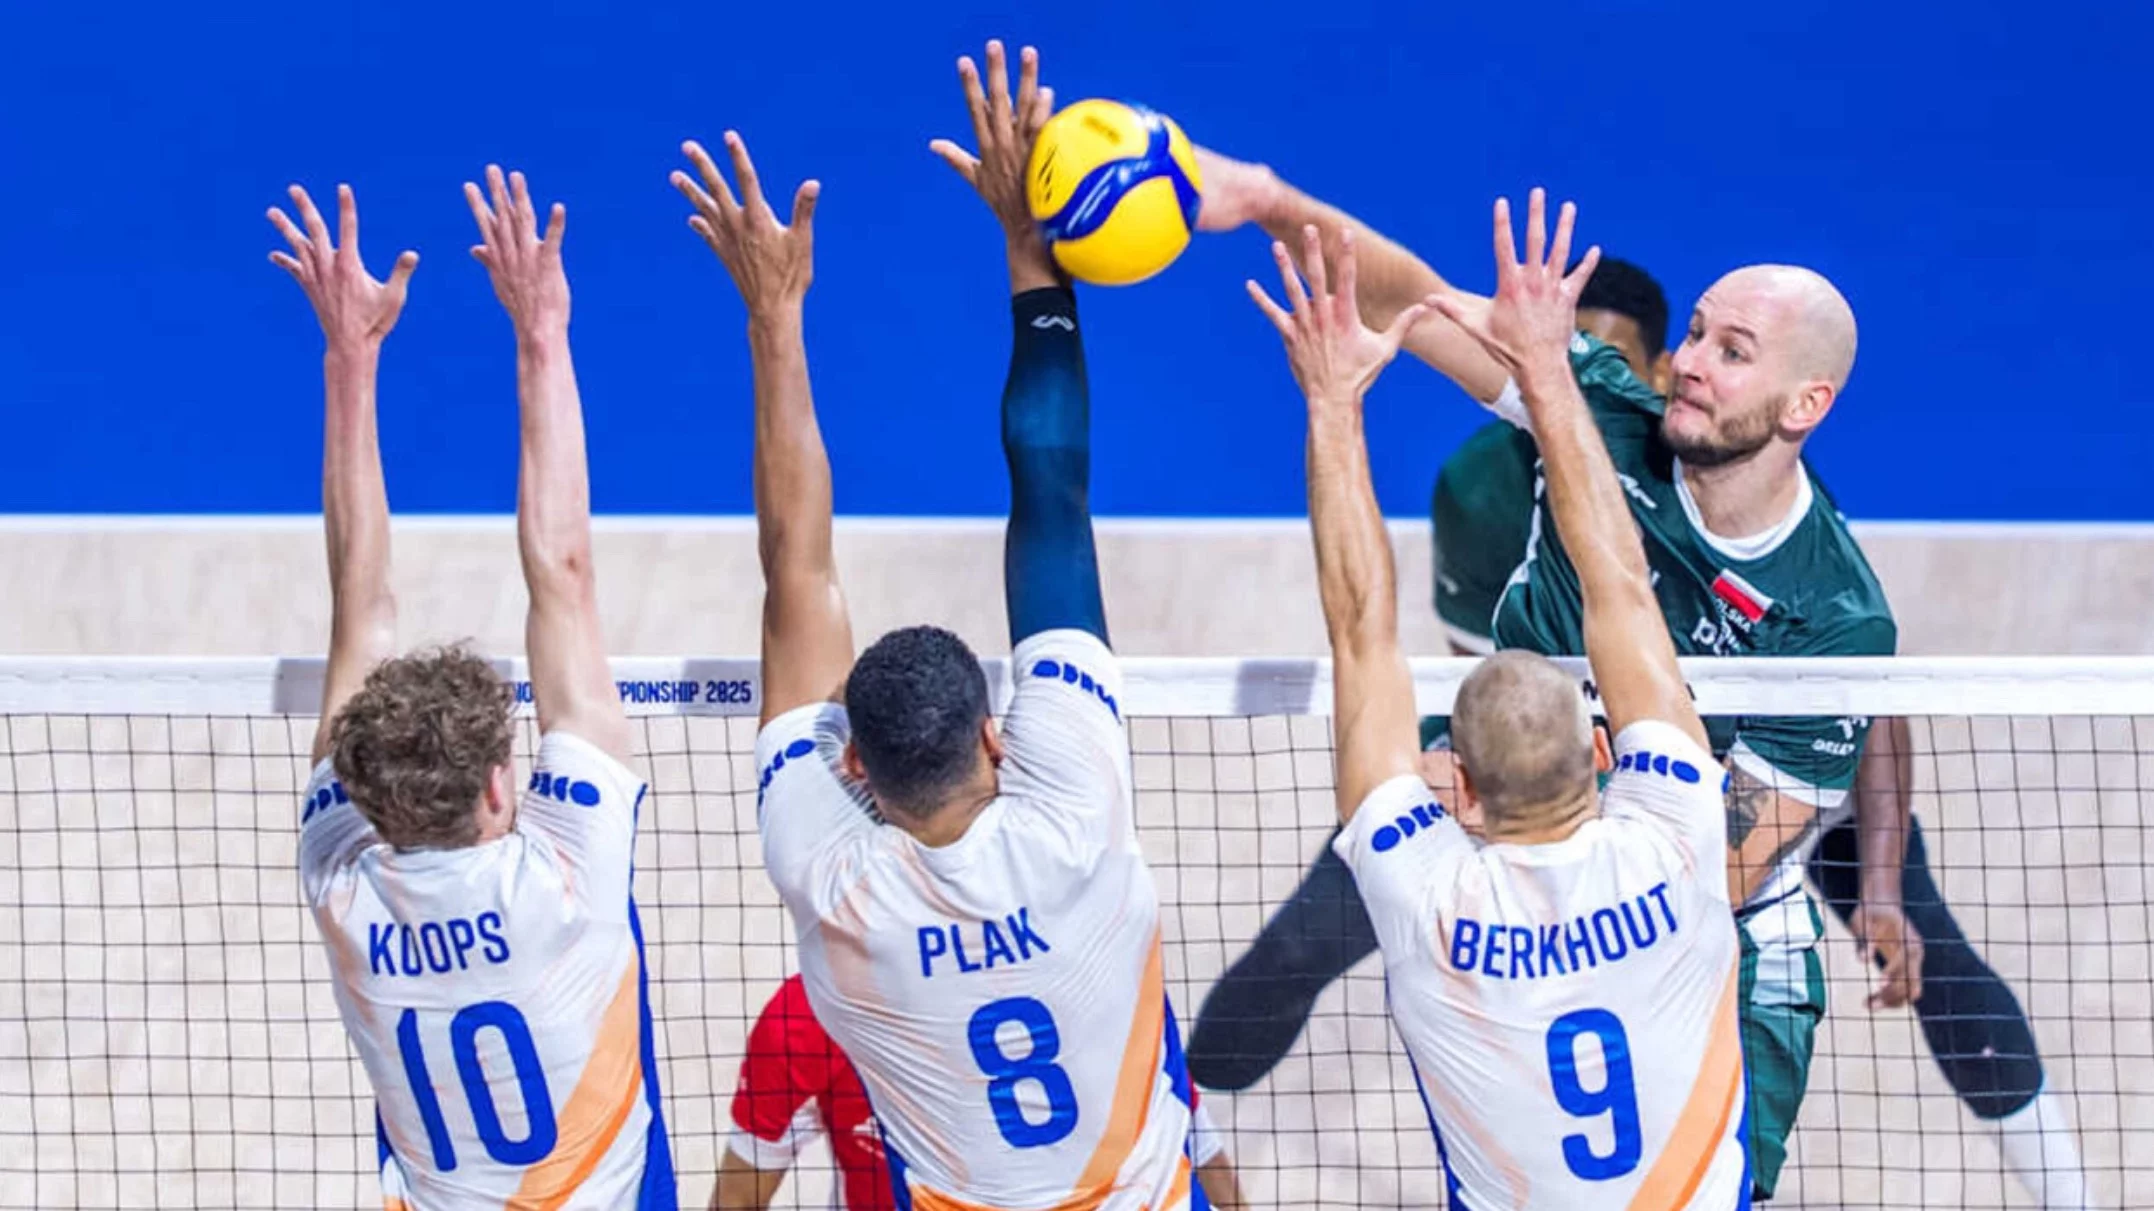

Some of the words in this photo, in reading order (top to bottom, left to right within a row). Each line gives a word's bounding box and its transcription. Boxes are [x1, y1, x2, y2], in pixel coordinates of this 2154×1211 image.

[616, 680, 699, 703] PIONSHIP
[369, 911, 511, 977] KOOPS
[917, 906, 1051, 978] PLAK
[1451, 882, 1679, 980] BERKHOUT
[397, 1000, 558, 1173] 10
[967, 996, 1079, 1149] 8
[1546, 1008, 1643, 1182] 9
